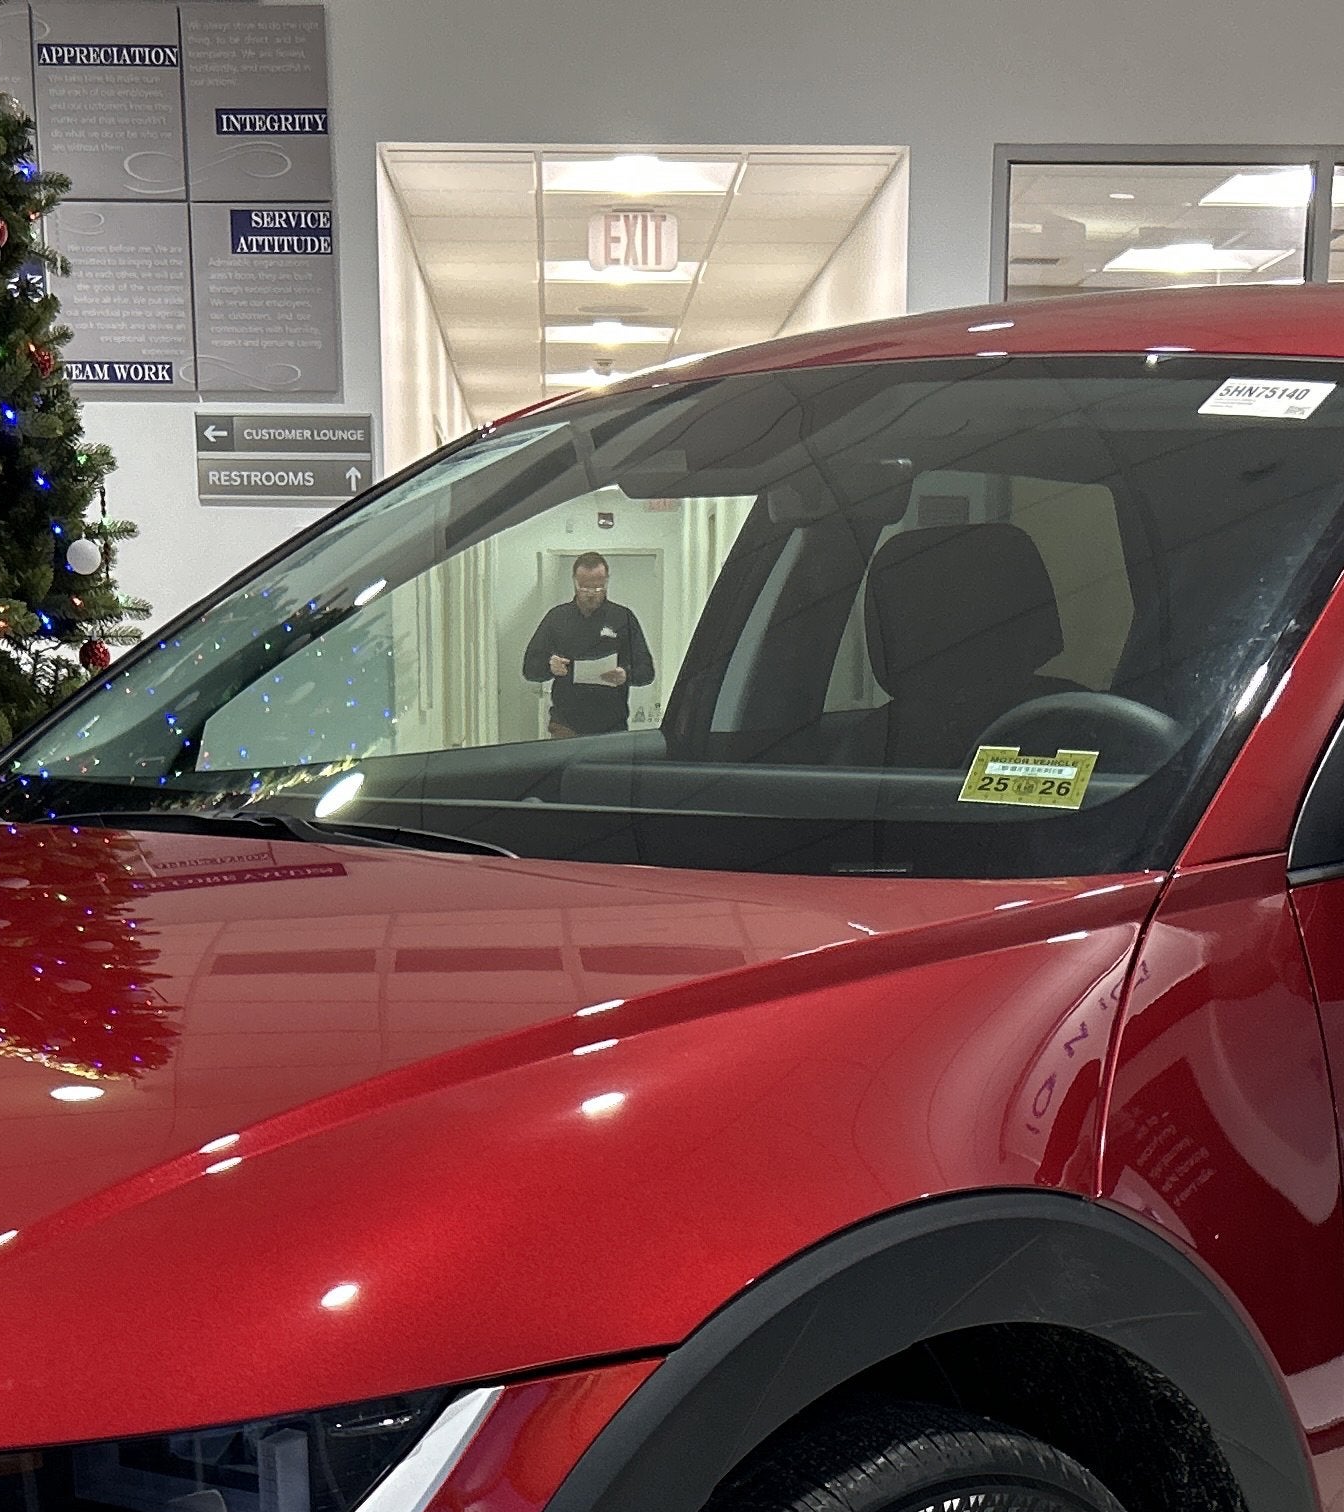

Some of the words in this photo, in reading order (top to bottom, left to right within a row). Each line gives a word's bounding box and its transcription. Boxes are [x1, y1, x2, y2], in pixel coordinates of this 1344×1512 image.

[39, 46, 178, 65] APPRECIATION
[221, 114, 327, 132] INTEGRITY
[251, 211, 331, 228] SERVICE
[236, 236, 331, 253] ATTITUDE
[603, 213, 668, 266] EXIT
[62, 364, 110, 381] TEAM
[113, 364, 171, 381] WORK
[1218, 385, 1311, 401] 5HN75140
[243, 429, 312, 440] CUSTOMER
[314, 429, 365, 441] LOUNGE
[208, 471, 315, 486] RESTROOMS
[989, 756, 1030, 764] MOTOR
[1033, 758, 1079, 768] VEHICLE
[977, 776, 1010, 792] 25
[1039, 780, 1072, 796] 26
